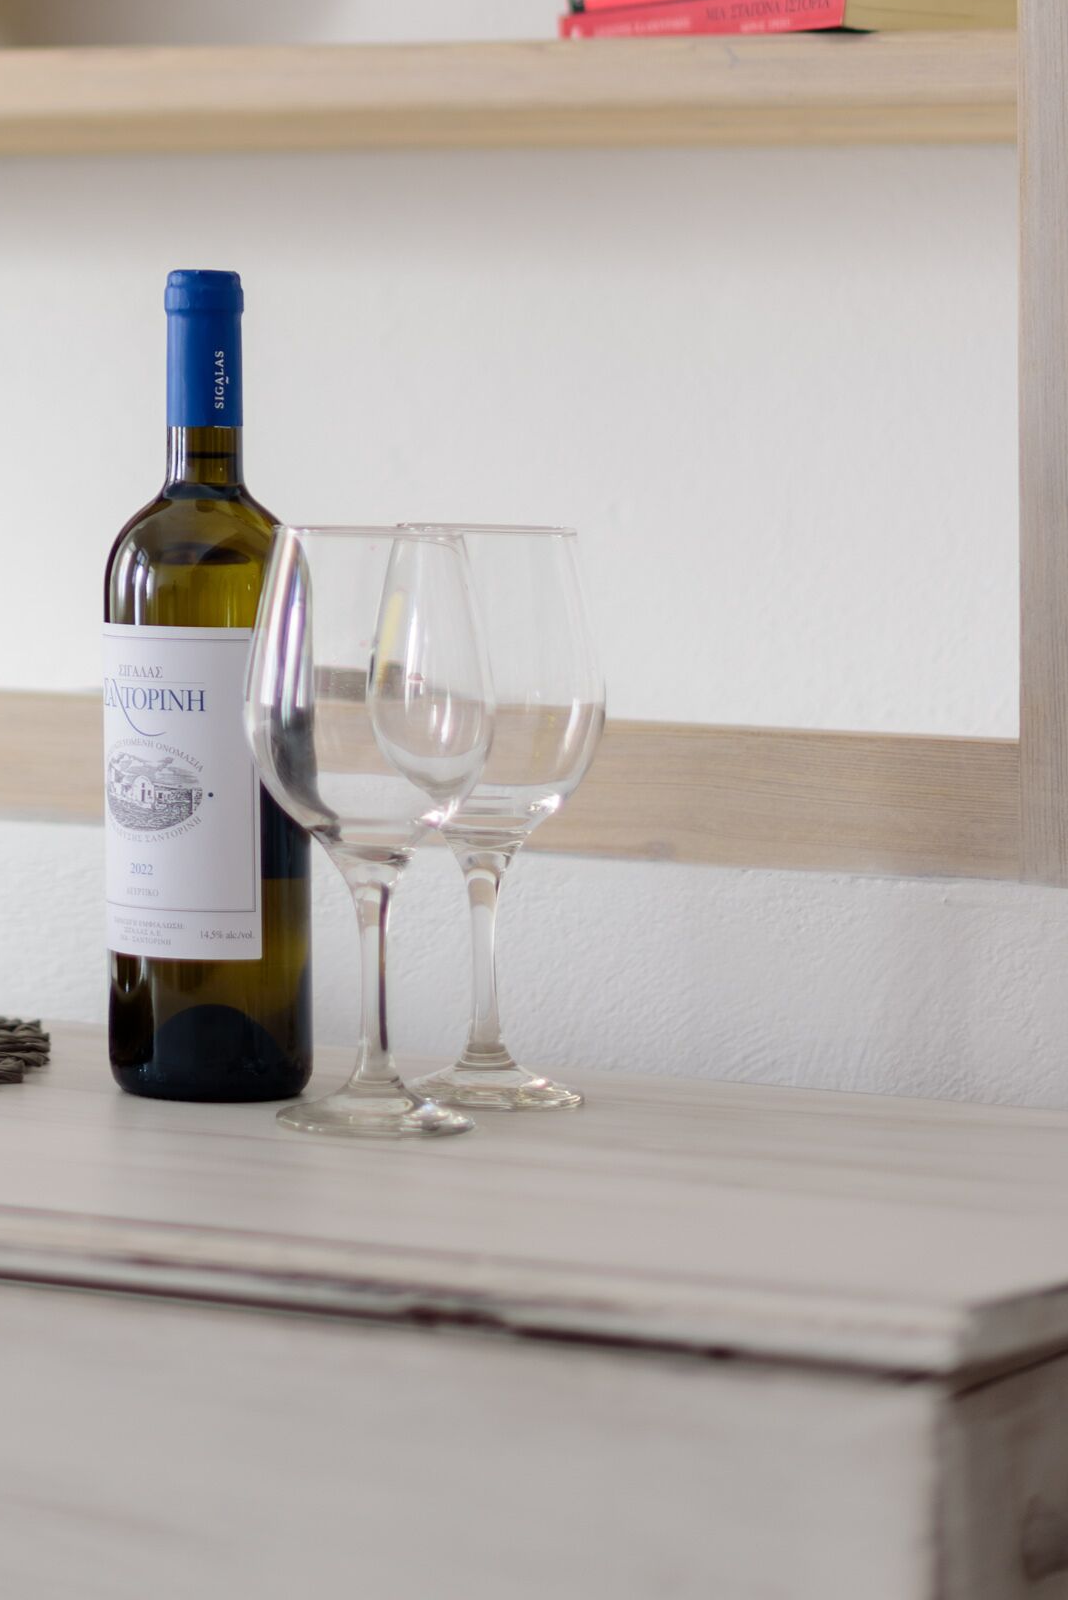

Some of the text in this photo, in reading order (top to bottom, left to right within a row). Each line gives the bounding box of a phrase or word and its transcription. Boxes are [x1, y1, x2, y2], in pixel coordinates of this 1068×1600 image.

[214, 350, 227, 410] SIGALAS
[118, 664, 163, 679] ΣΙΓΑΛΑΣ
[155, 741, 204, 773] ΟΝΟΜΑΣΙΑ
[130, 862, 154, 876] 2022
